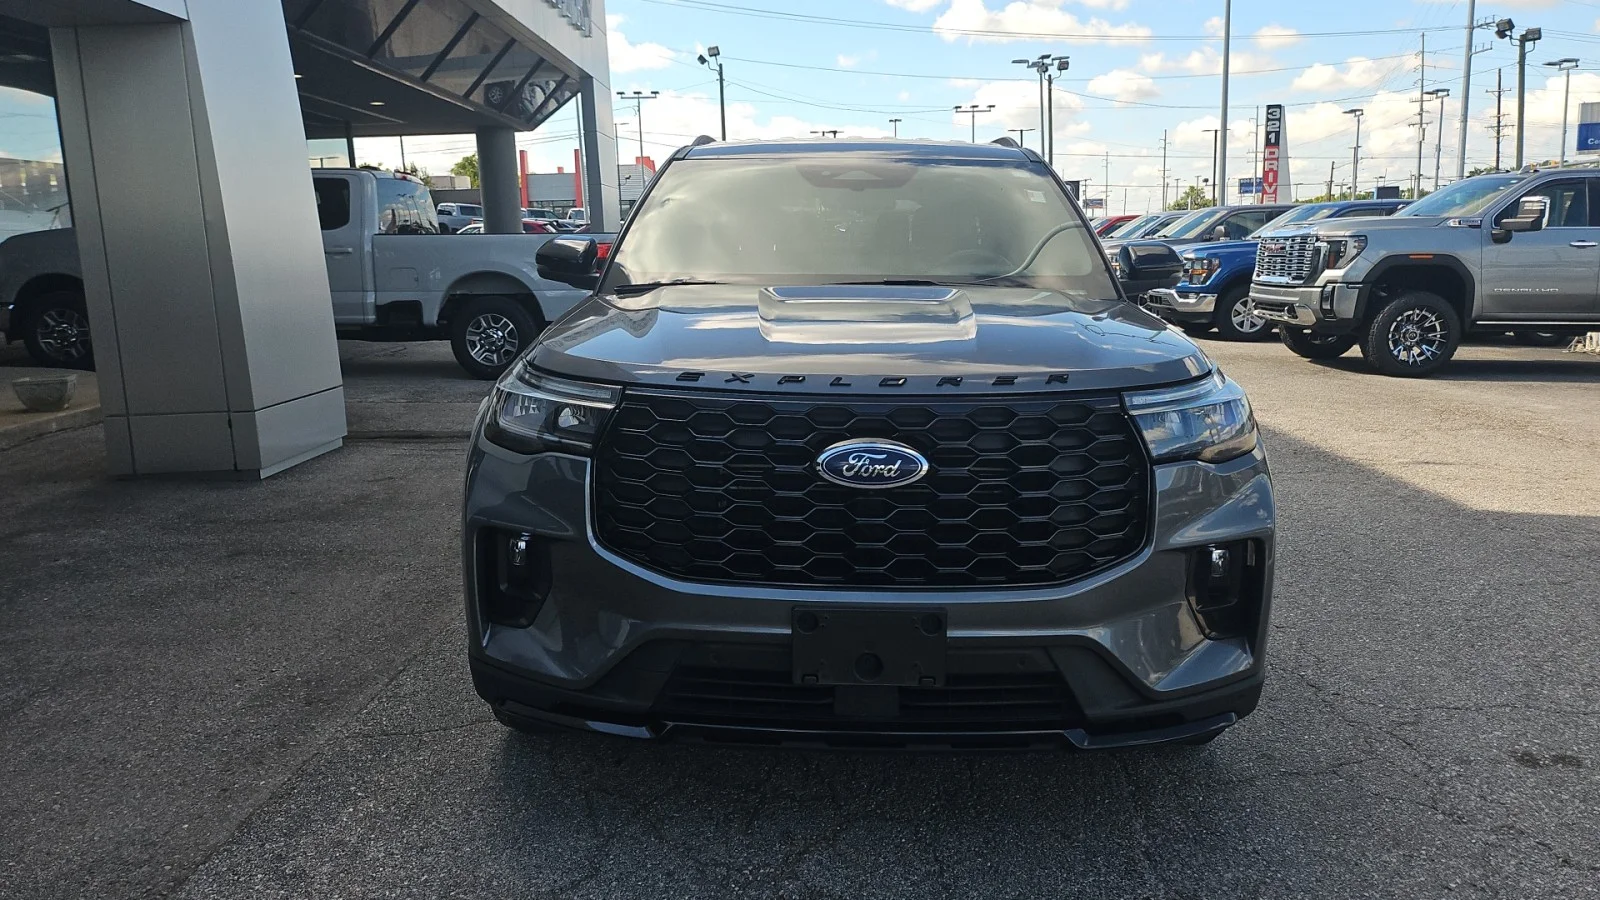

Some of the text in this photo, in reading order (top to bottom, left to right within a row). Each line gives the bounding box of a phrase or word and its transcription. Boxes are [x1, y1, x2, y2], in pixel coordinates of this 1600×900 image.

[1587, 137, 1600, 145] Ce
[1263, 108, 1281, 204] 321 DRIVE
[675, 371, 1072, 387] EXPLORER
[842, 452, 903, 478] Ford
